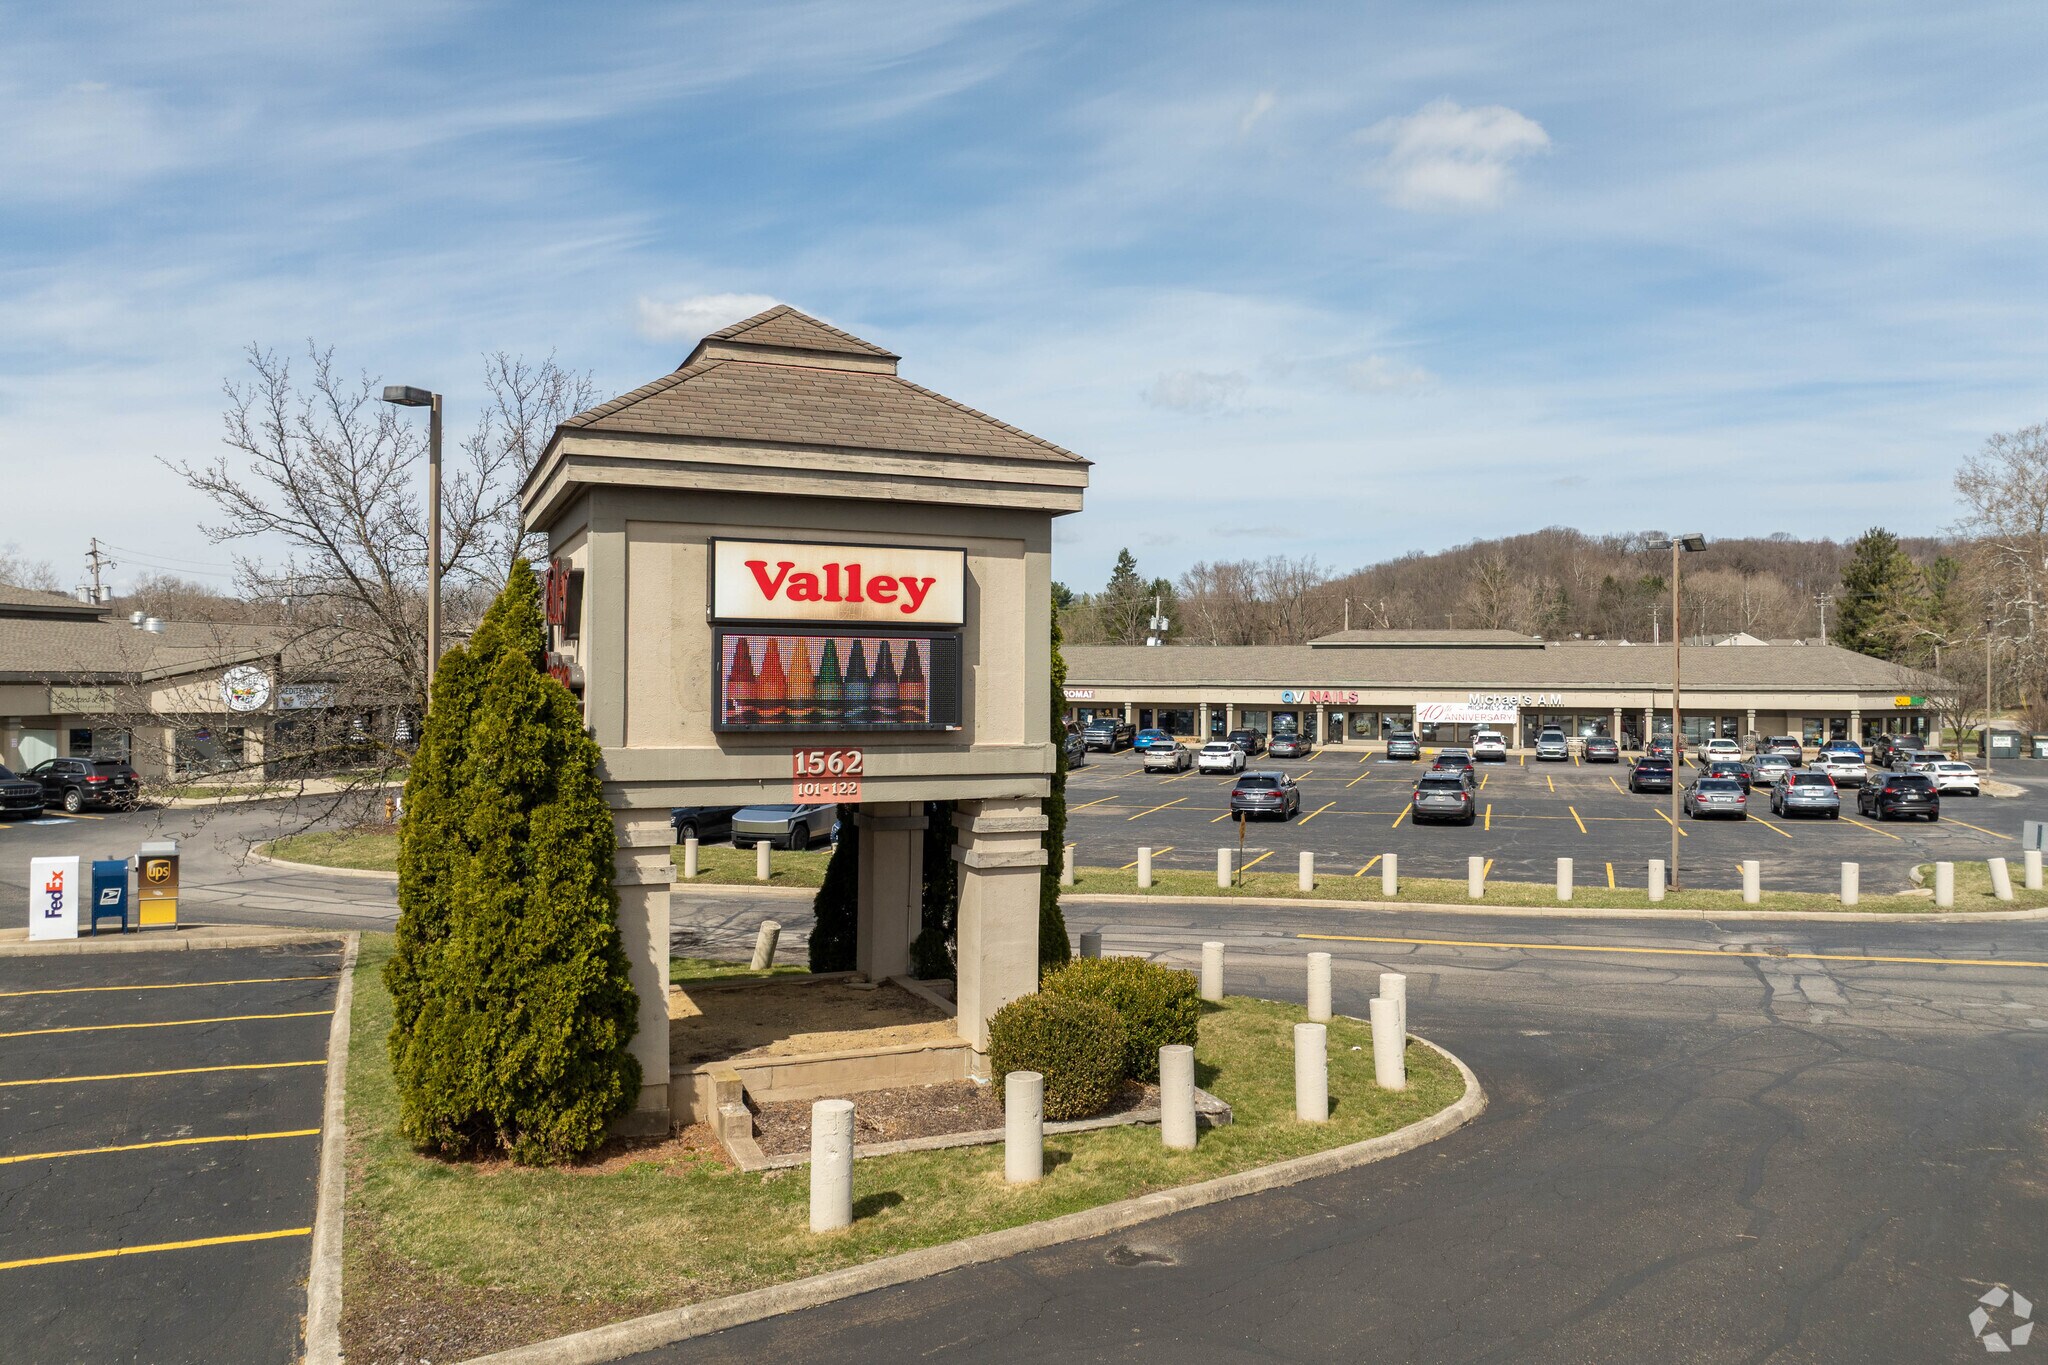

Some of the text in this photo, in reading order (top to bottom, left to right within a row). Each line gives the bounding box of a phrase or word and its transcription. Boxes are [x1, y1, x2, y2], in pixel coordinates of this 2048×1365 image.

[744, 560, 936, 614] Valley
[1281, 690, 1358, 704] QV NAILS
[1469, 693, 1565, 706] Michael's A.M.
[1445, 713, 1516, 722] ANNIVERSARY!
[795, 750, 863, 775] 1562
[148, 865, 169, 880] ups
[45, 870, 64, 918] FedEx
